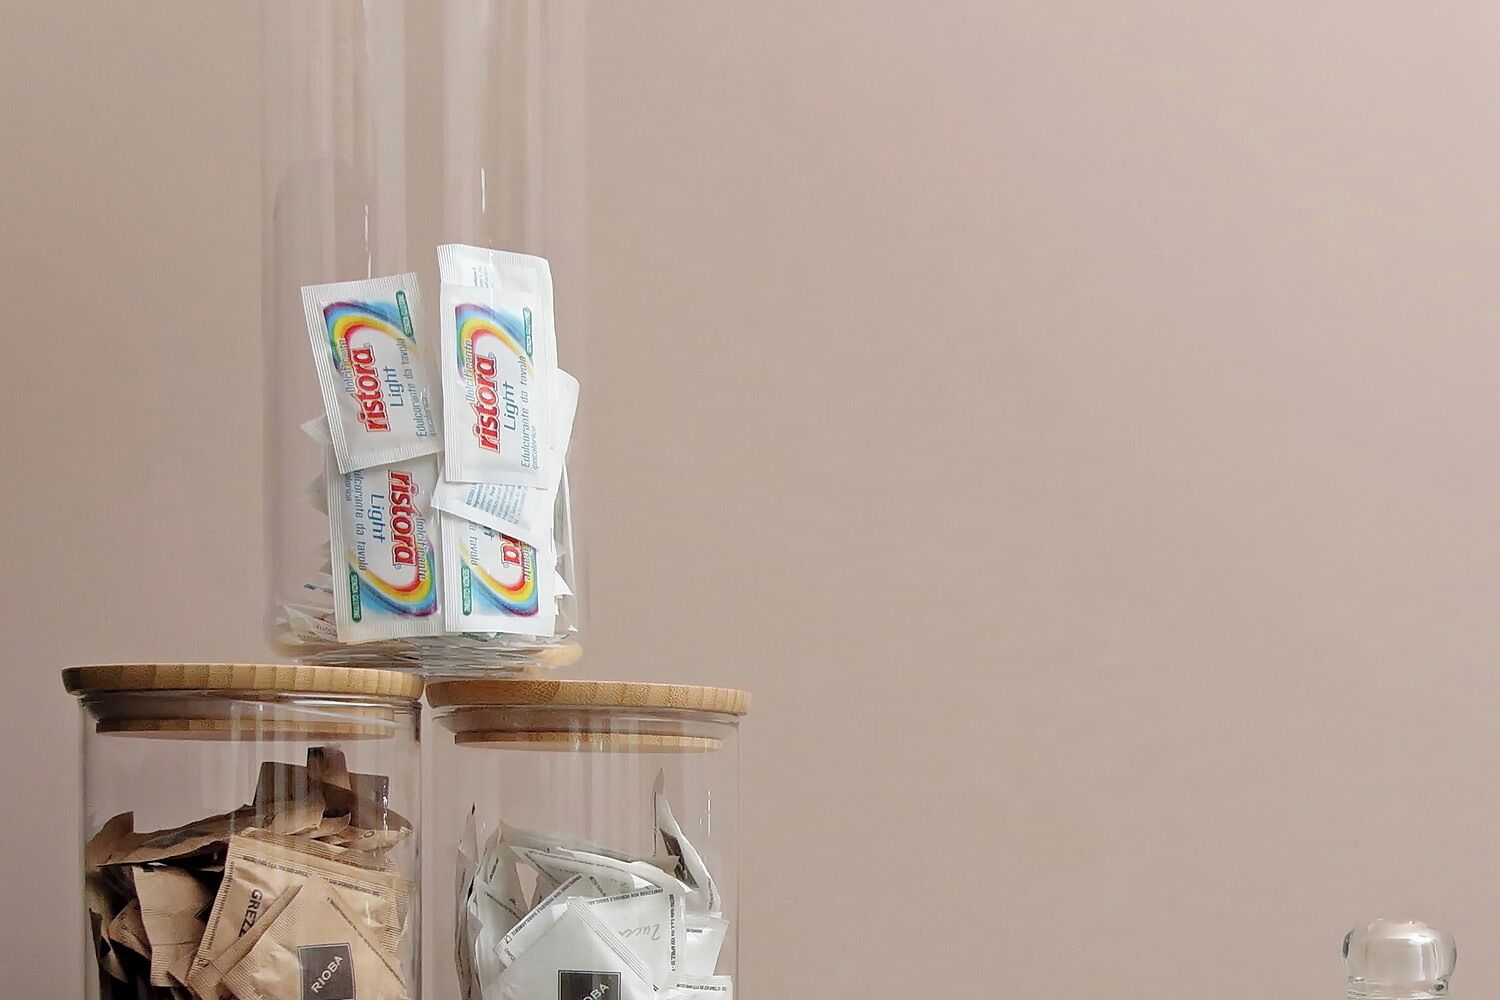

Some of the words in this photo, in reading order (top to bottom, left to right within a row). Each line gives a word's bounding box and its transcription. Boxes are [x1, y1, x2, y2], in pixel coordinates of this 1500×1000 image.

[400, 337, 409, 365] tavola
[403, 367, 414, 380] da
[518, 355, 527, 386] tavola
[351, 344, 390, 432] ristora
[383, 366, 404, 408] Light
[473, 353, 501, 454] ristora
[501, 380, 516, 432] Light
[519, 390, 529, 403] da
[407, 382, 428, 438] Edulcorante
[519, 408, 531, 469] Edulcorante
[352, 466, 365, 519] ulcorante
[355, 522, 365, 539] da
[369, 493, 386, 544] Light
[389, 470, 418, 569] ristora
[356, 541, 369, 572] tavola
[469, 535, 478, 567] tavola
[238, 889, 263, 938] GREZ
[310, 953, 344, 994] RIOBA
